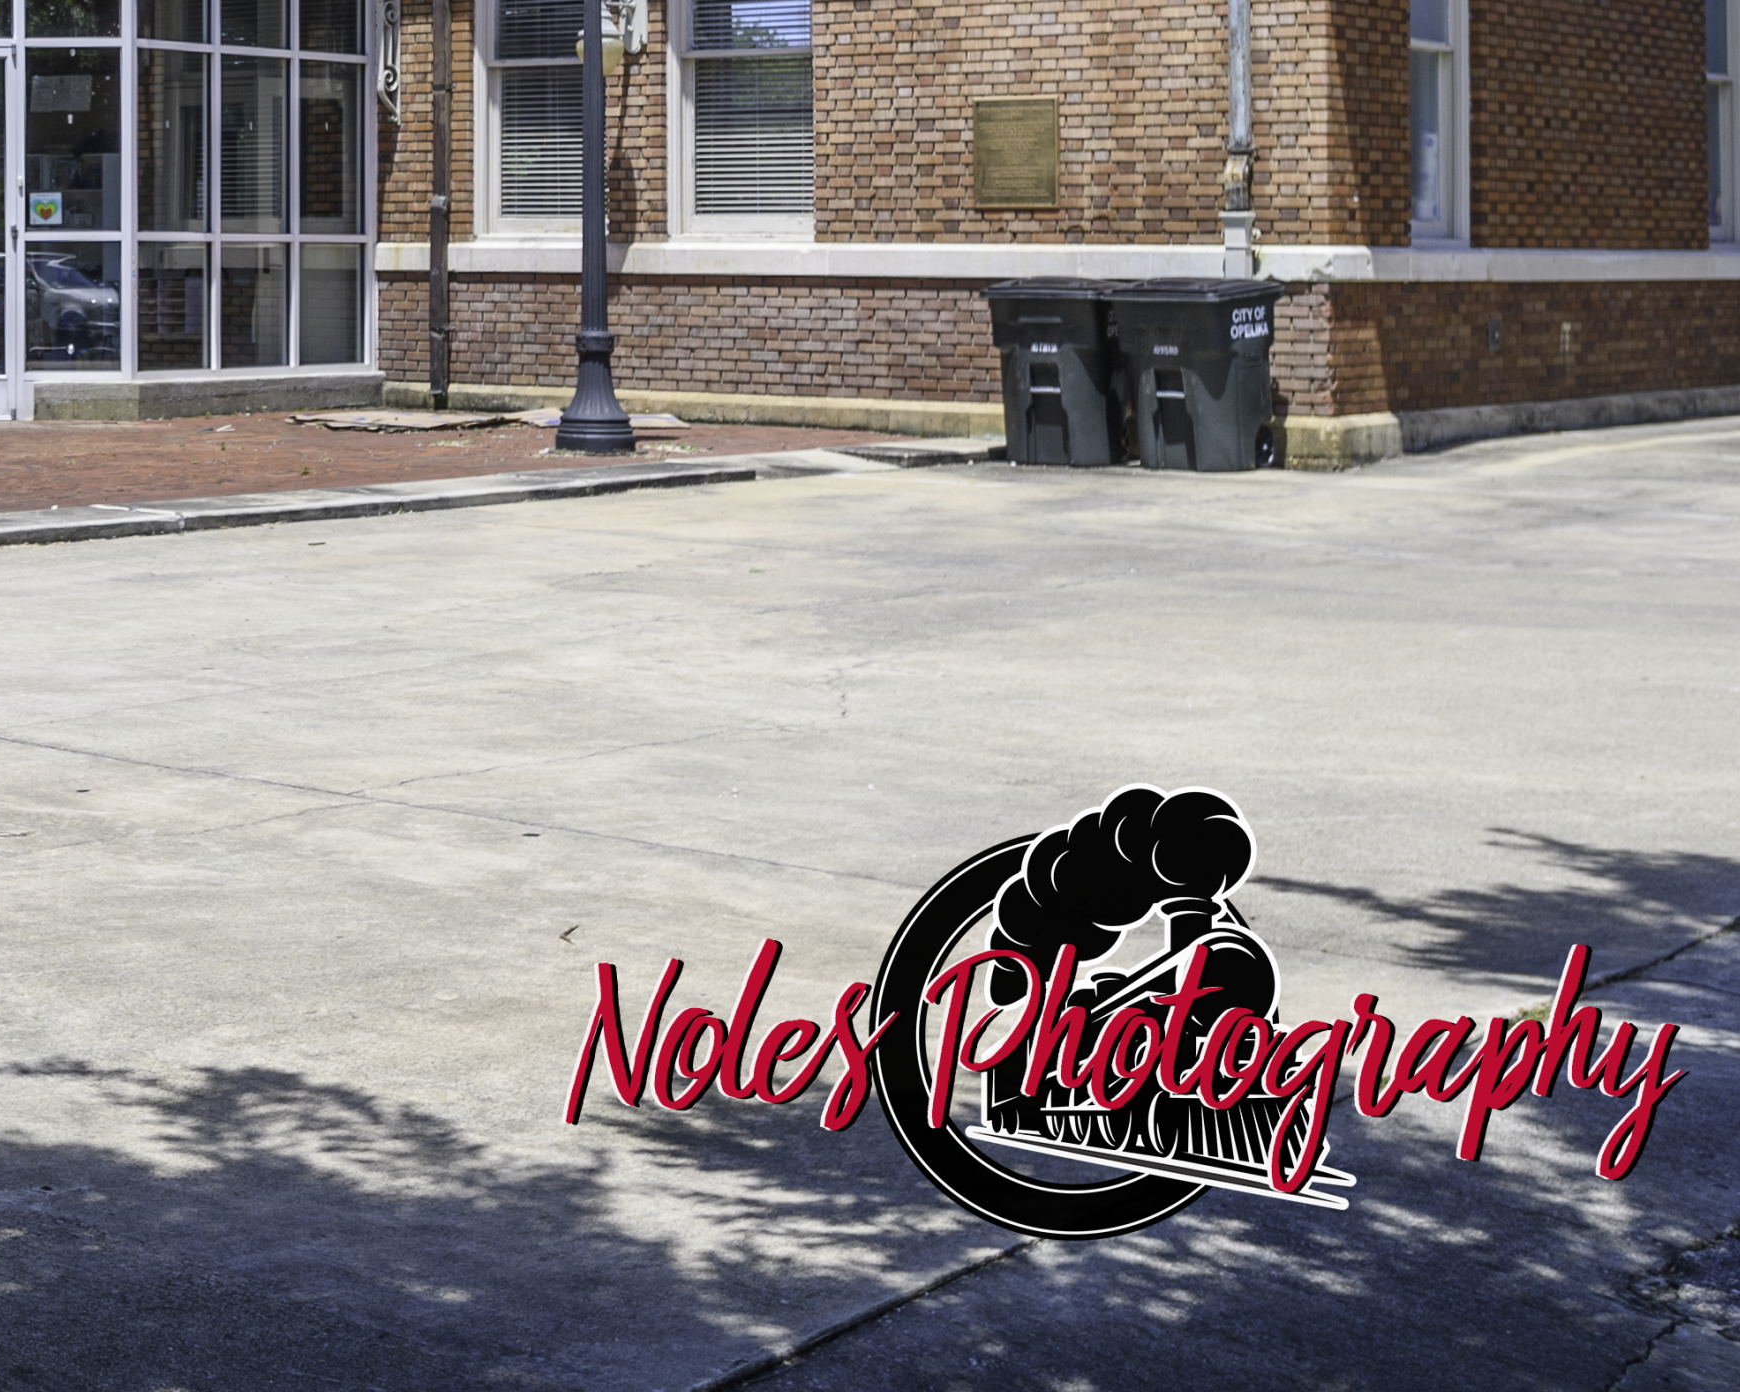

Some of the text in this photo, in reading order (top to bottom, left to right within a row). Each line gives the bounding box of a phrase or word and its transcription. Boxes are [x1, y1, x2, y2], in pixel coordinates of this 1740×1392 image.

[1232, 304, 1266, 324] CITY OF
[1230, 321, 1270, 340] OPELIKA
